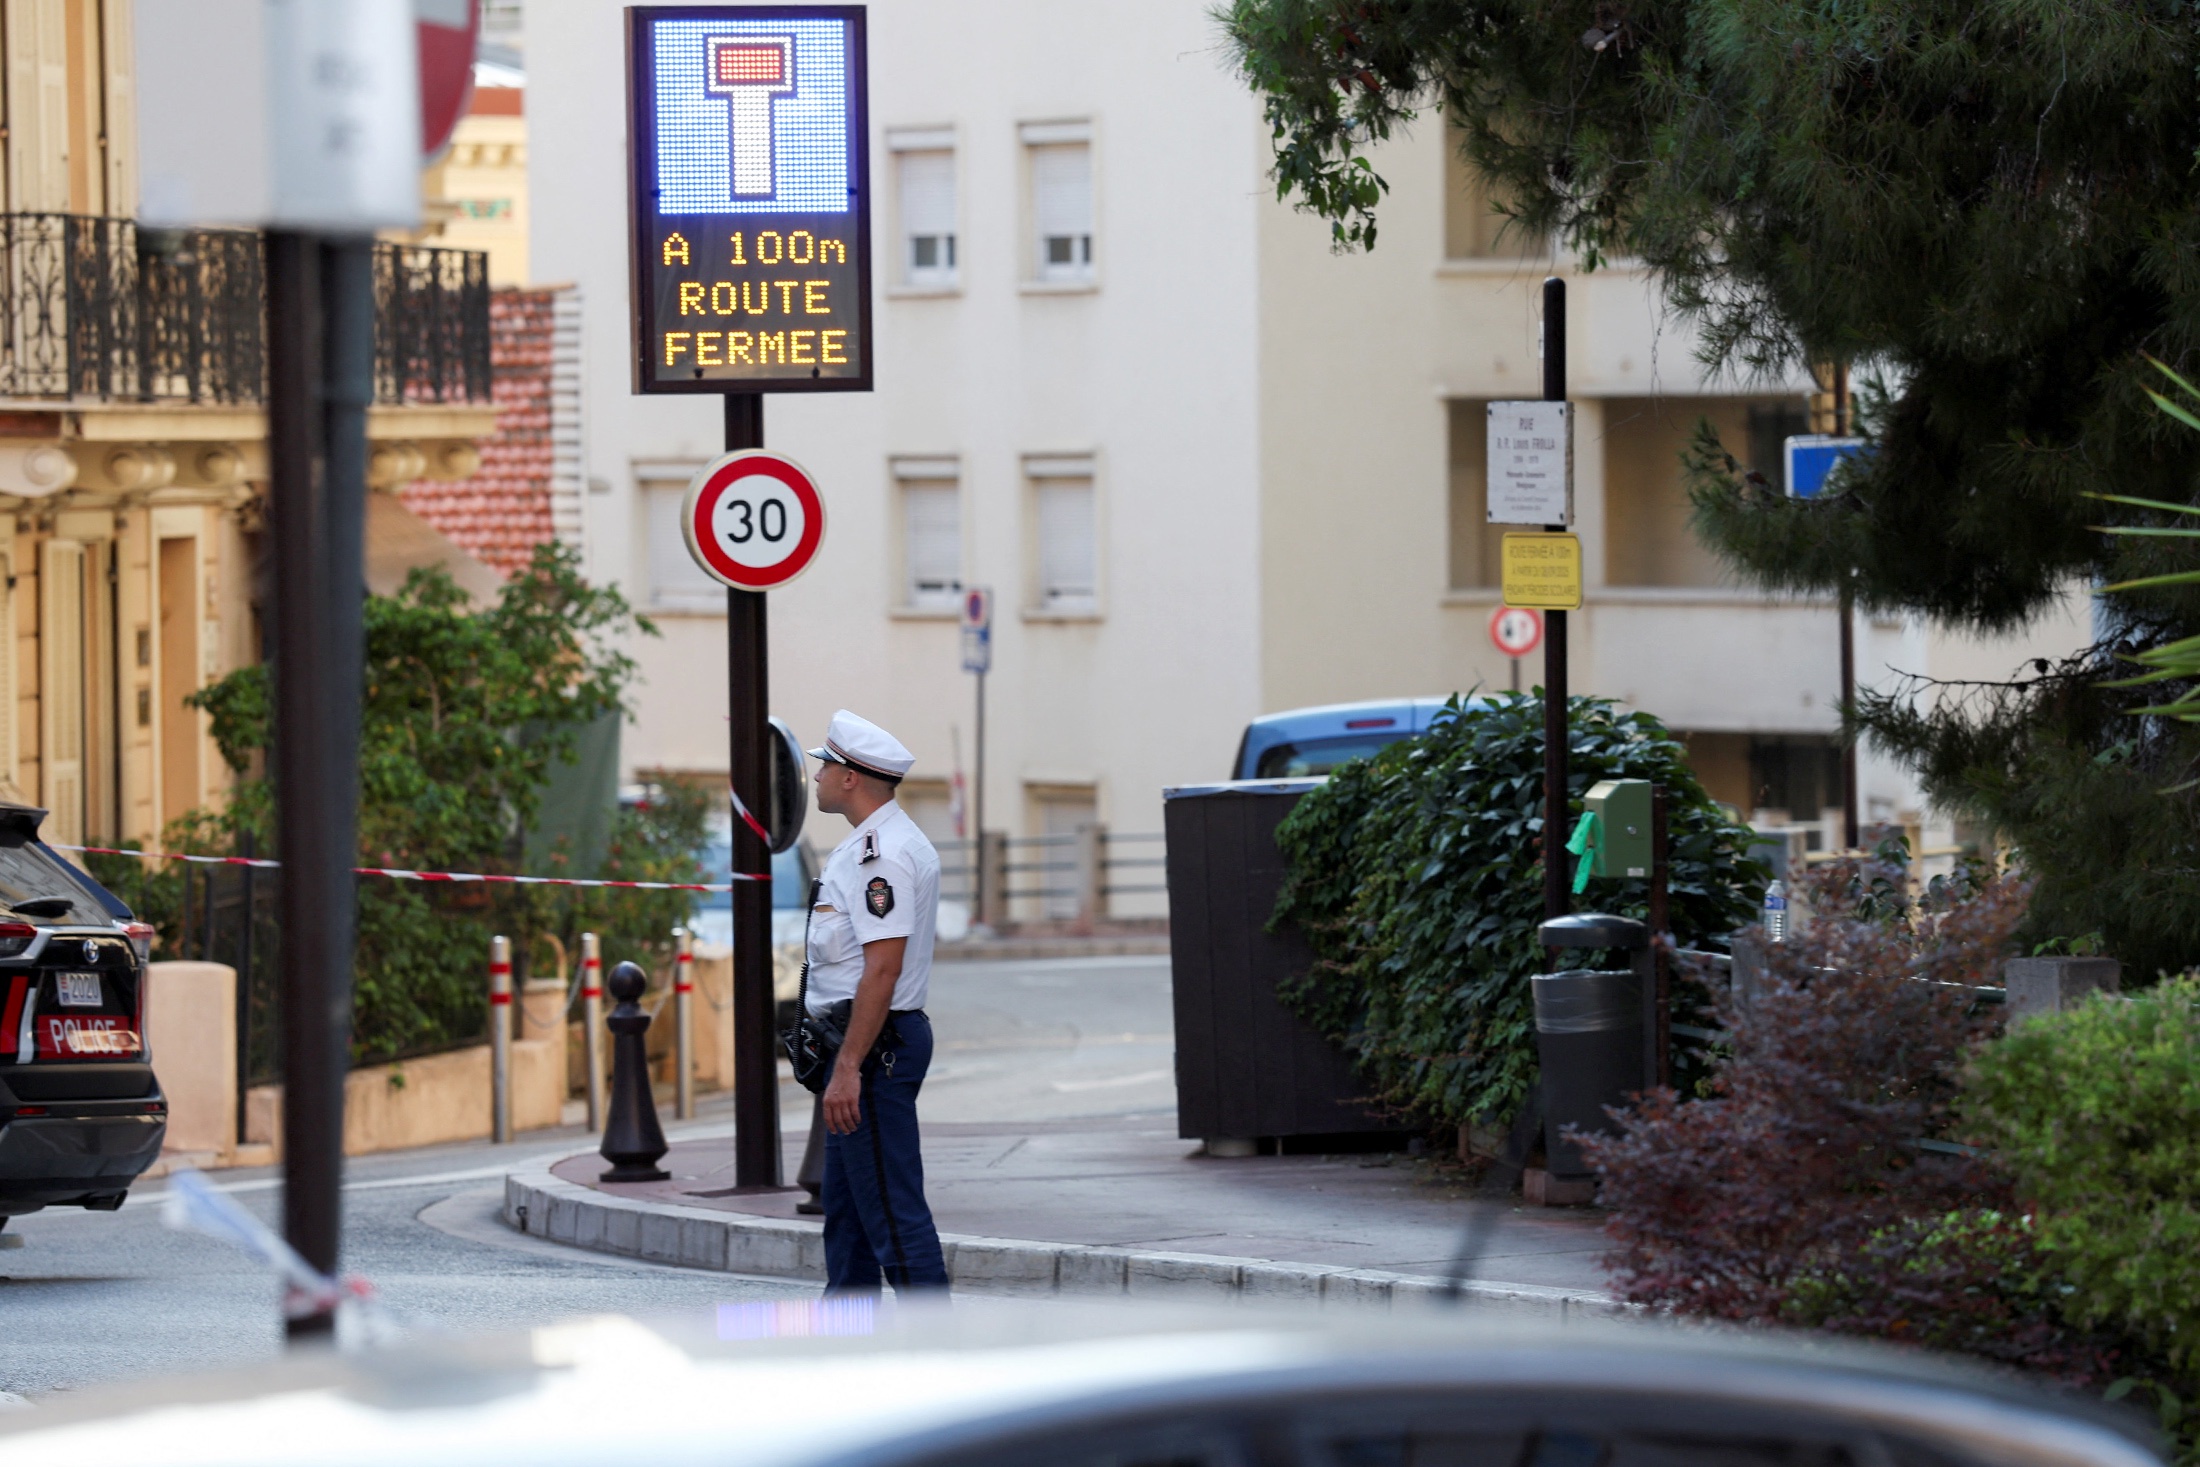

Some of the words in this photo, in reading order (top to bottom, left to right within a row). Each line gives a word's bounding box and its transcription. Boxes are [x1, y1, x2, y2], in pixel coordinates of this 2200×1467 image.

[730, 230, 847, 266] 100m
[679, 280, 831, 316] ROUTE
[665, 330, 848, 366] FERMEE
[726, 498, 788, 544] 30
[50, 1019, 122, 1055] POLICE
